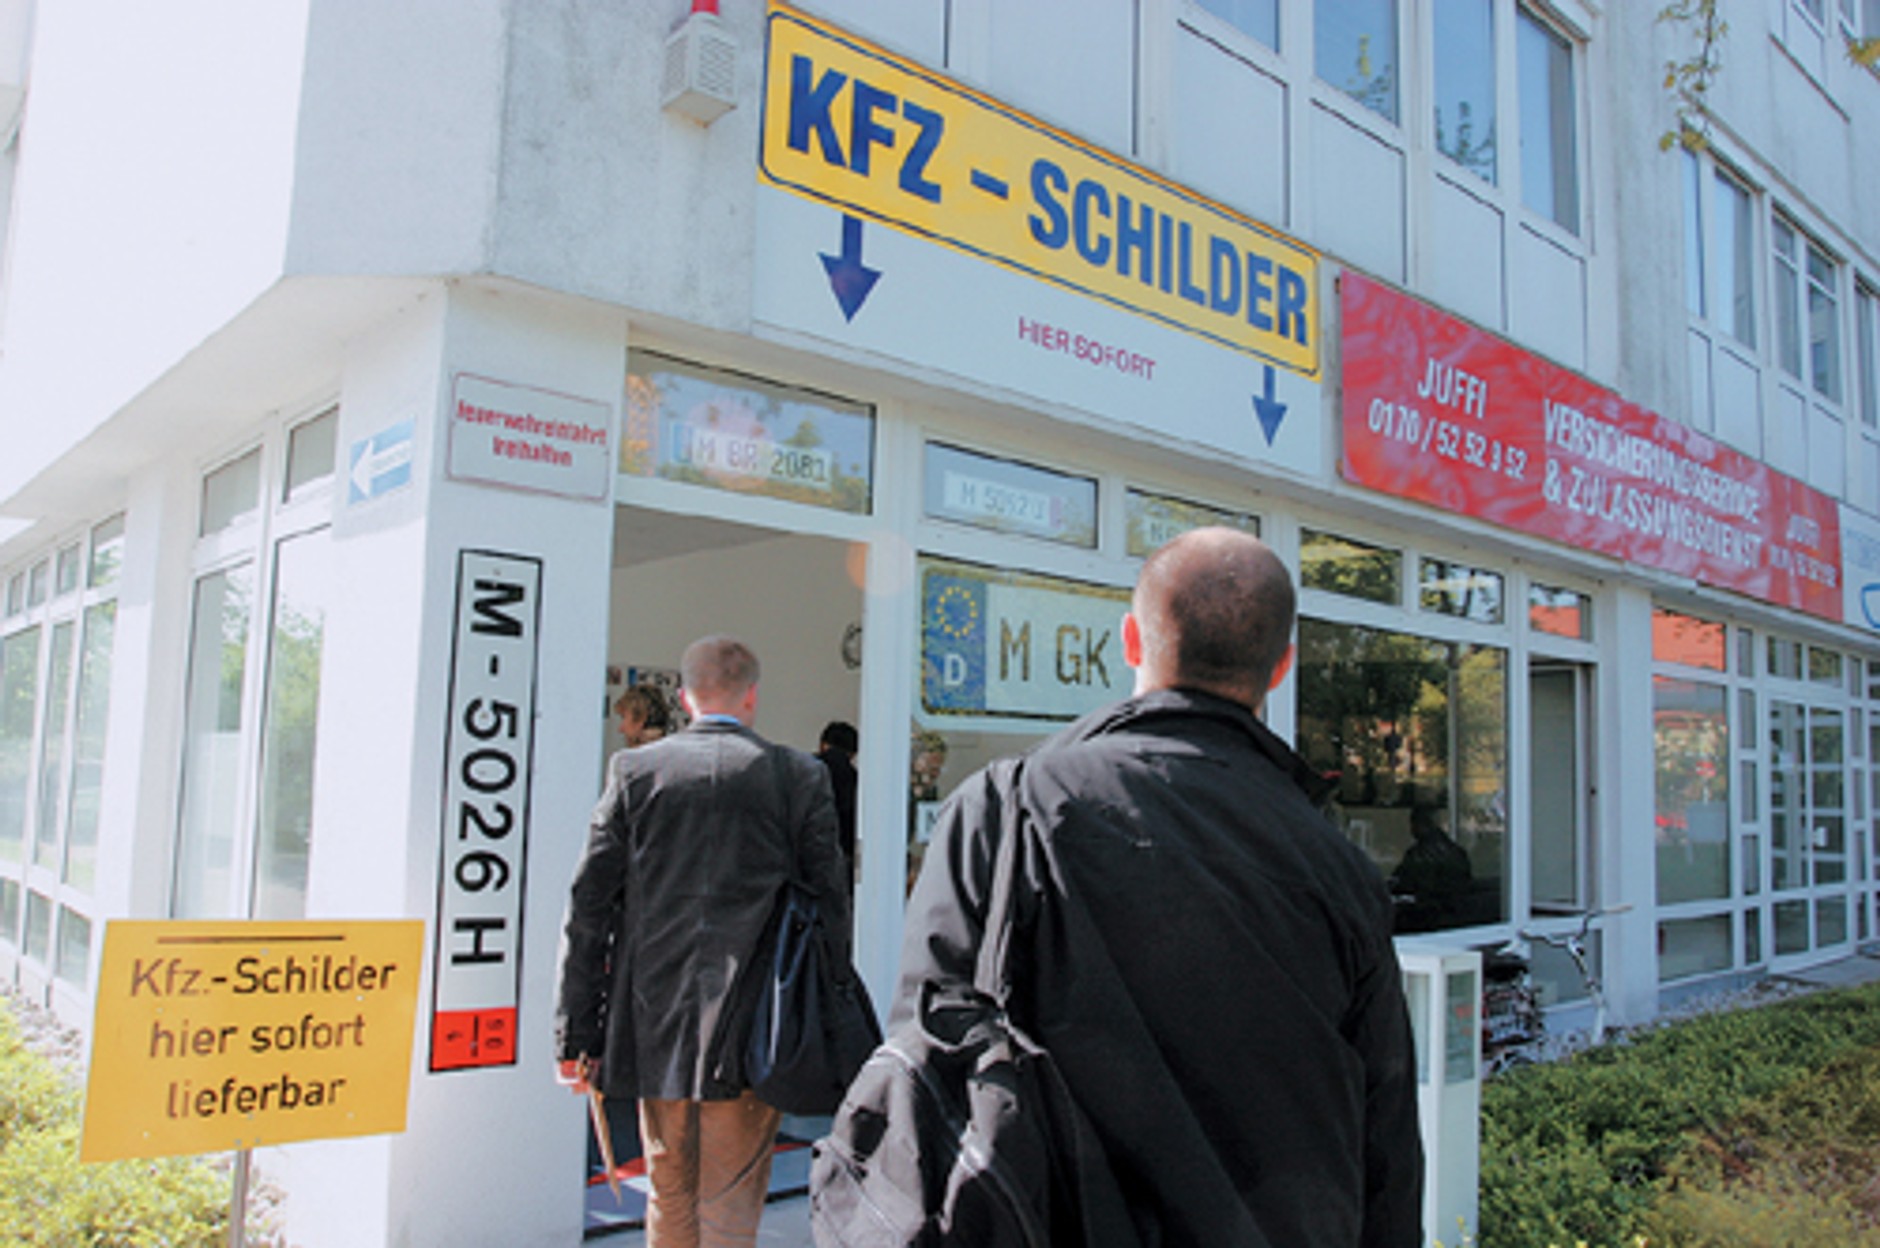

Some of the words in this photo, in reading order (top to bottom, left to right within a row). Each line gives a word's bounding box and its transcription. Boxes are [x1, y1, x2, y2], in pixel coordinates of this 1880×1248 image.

[787, 53, 945, 205] KFZ
[1027, 158, 1308, 348] SCHILDER
[1018, 316, 1070, 354] HIER
[1074, 335, 1156, 381] SOFORT
[1417, 358, 1487, 419] JUFFI
[1368, 398, 1419, 444] 0170
[1436, 421, 1460, 459] 52
[1464, 431, 1487, 468] 52
[1542, 459, 1562, 504] &
[470, 579, 526, 637] M
[944, 653, 967, 687] D
[1000, 617, 1030, 682] M
[1056, 624, 1111, 689] GK
[454, 697, 517, 893] 5026
[451, 917, 506, 966] H
[130, 956, 396, 997] Kfz.-Schilder
[149, 1018, 238, 1059] hier
[250, 1013, 366, 1053] sofort
[167, 1074, 347, 1119] lieferbar
